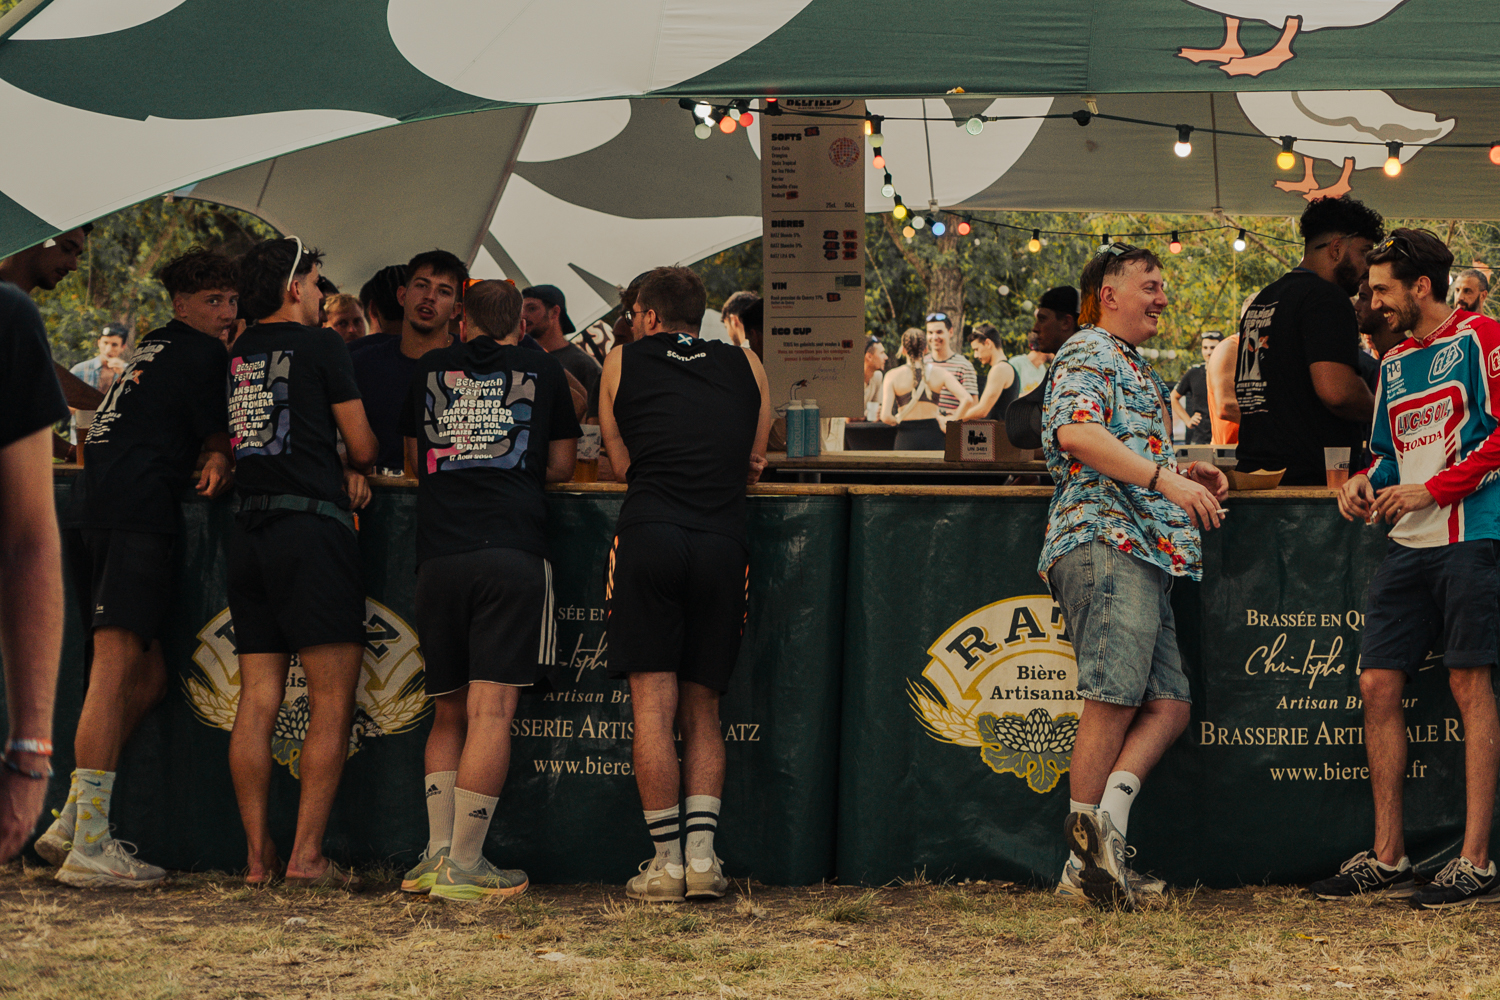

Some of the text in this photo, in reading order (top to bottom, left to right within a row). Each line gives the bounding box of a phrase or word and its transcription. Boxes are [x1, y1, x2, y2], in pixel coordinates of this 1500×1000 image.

[771, 133, 802, 141] SOFTS
[771, 218, 804, 228] BIÈRES
[772, 282, 787, 290] VIN
[771, 326, 812, 336] ÉCO CUP
[666, 350, 707, 362] SCOTLAND
[455, 378, 503, 388] BELFIELD
[453, 387, 504, 396] FESTIVAL
[452, 399, 501, 408] ANSBRO
[442, 407, 512, 416] EARGASM GOD
[437, 414, 515, 425] TONY ROMERA
[450, 435, 495, 443] BEL'CREW
[1403, 430, 1443, 452] HONDA
[1246, 608, 1315, 628] BRASSÉE
[1321, 613, 1341, 627] EN
[945, 606, 1072, 672] RA
[1016, 664, 1067, 681] Bière
[543, 690, 604, 703] Artisan
[989, 685, 1084, 701] Artisana
[1276, 695, 1338, 710] Artisan
[510, 719, 573, 738] SSERIE
[722, 722, 760, 742] ATZ
[1200, 719, 1309, 746] BRASSERIE
[1314, 719, 1439, 746] ARTIALE
[533, 756, 636, 776] www.biere
[1269, 759, 1427, 782] www.biere.fr
